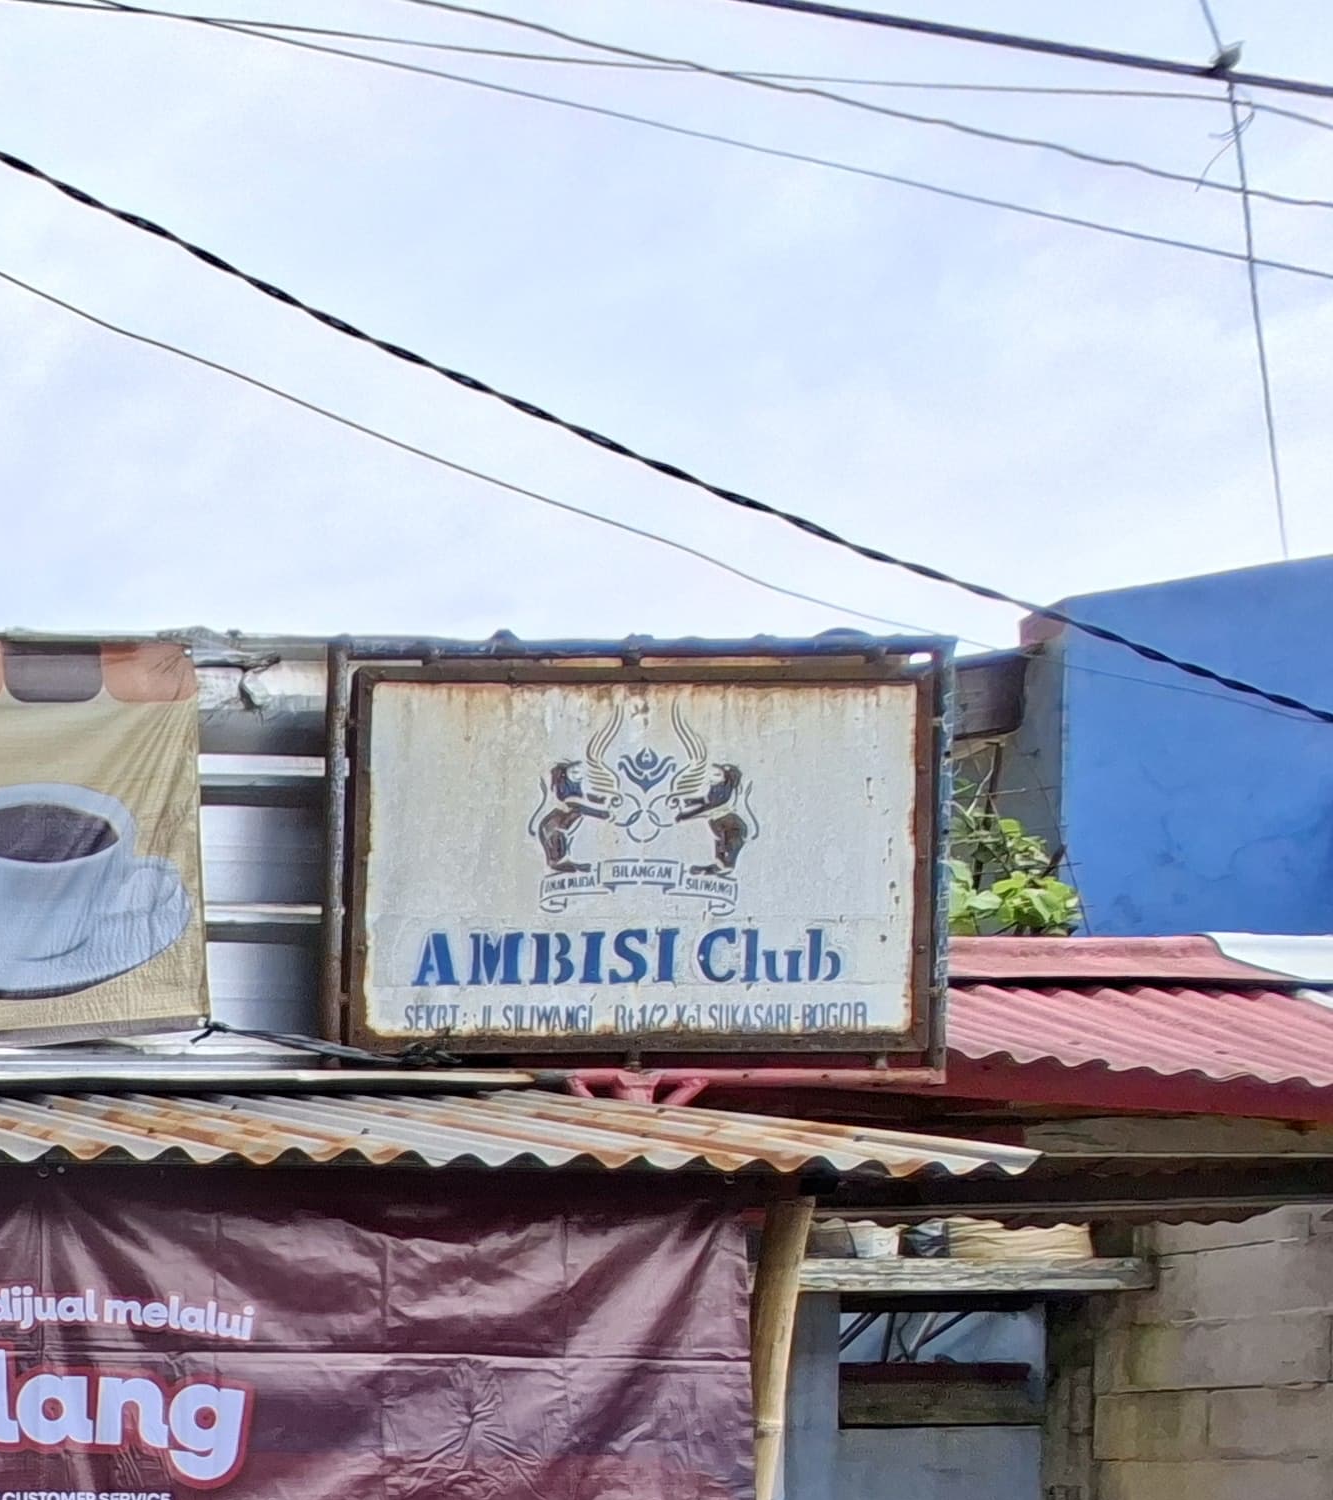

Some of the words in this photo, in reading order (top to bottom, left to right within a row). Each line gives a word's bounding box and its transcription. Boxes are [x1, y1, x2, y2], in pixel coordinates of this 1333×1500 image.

[612, 865, 672, 879] BILANGAN
[412, 927, 680, 986] AMBISI
[696, 927, 841, 983] Club
[105, 1296, 254, 1341] melalui
